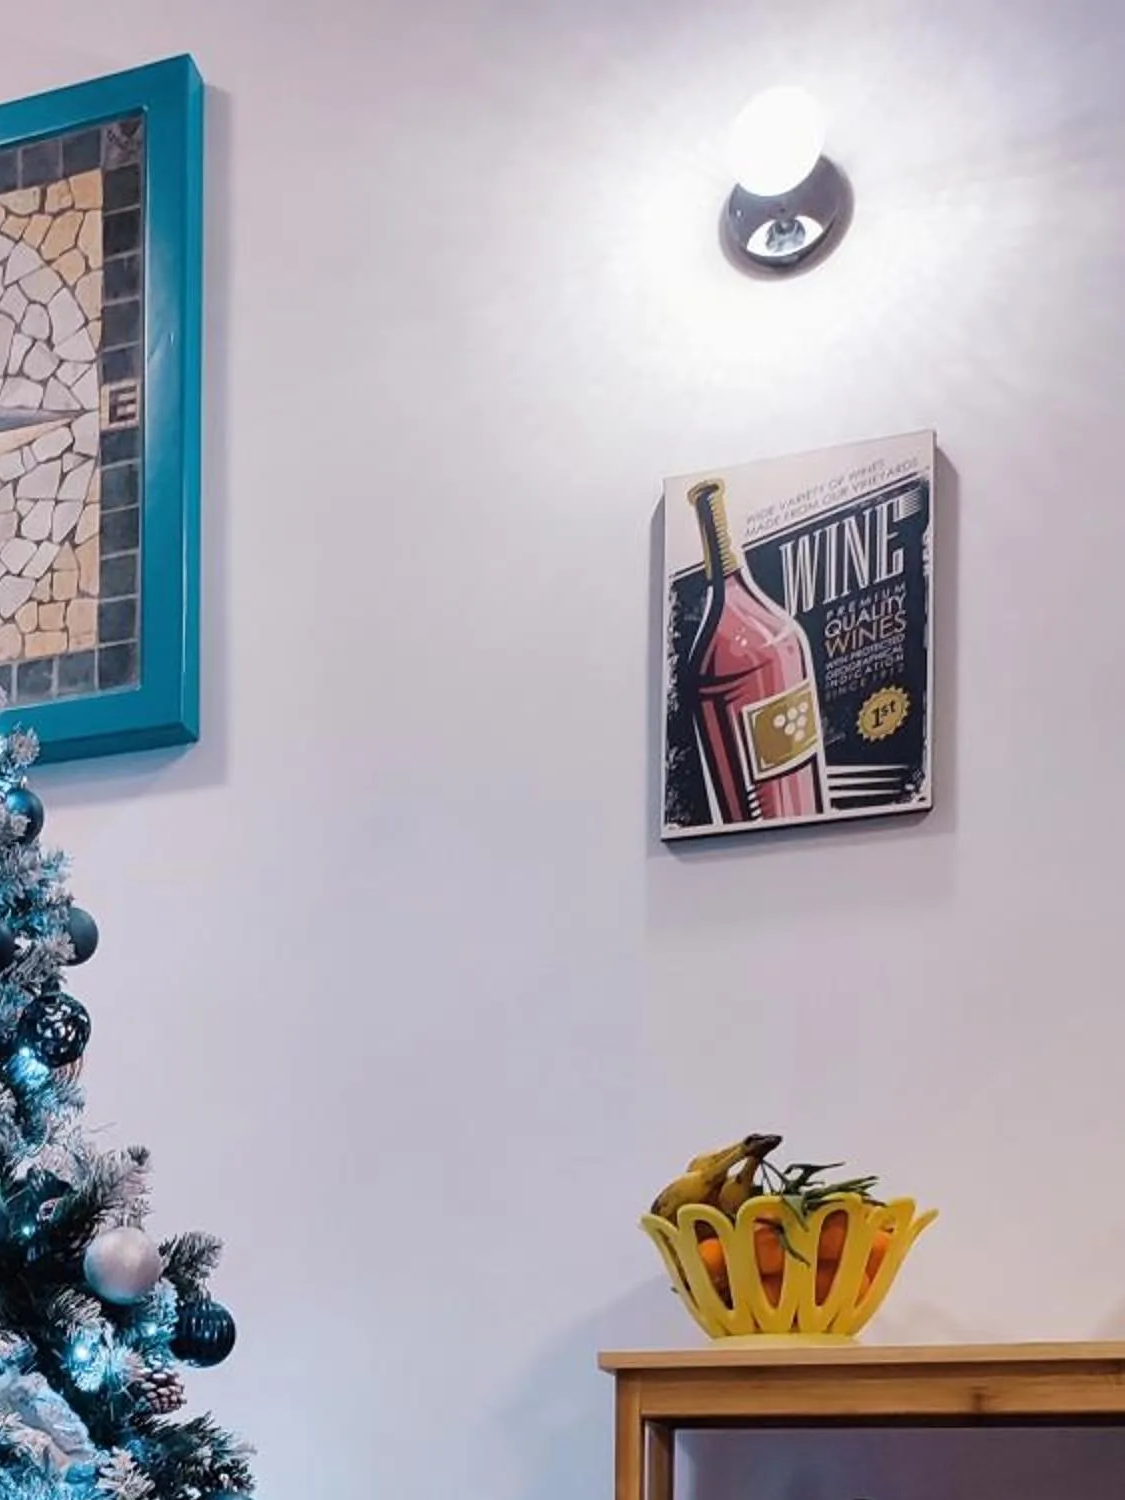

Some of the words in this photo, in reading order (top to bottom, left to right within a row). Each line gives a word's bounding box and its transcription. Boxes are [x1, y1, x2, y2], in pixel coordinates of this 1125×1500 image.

[108, 385, 137, 424] E
[779, 497, 905, 617] WINE
[825, 592, 906, 638] QUALITY
[826, 582, 906, 621] PREMIUM
[825, 610, 906, 658] WINES
[871, 699, 896, 728] 1st
